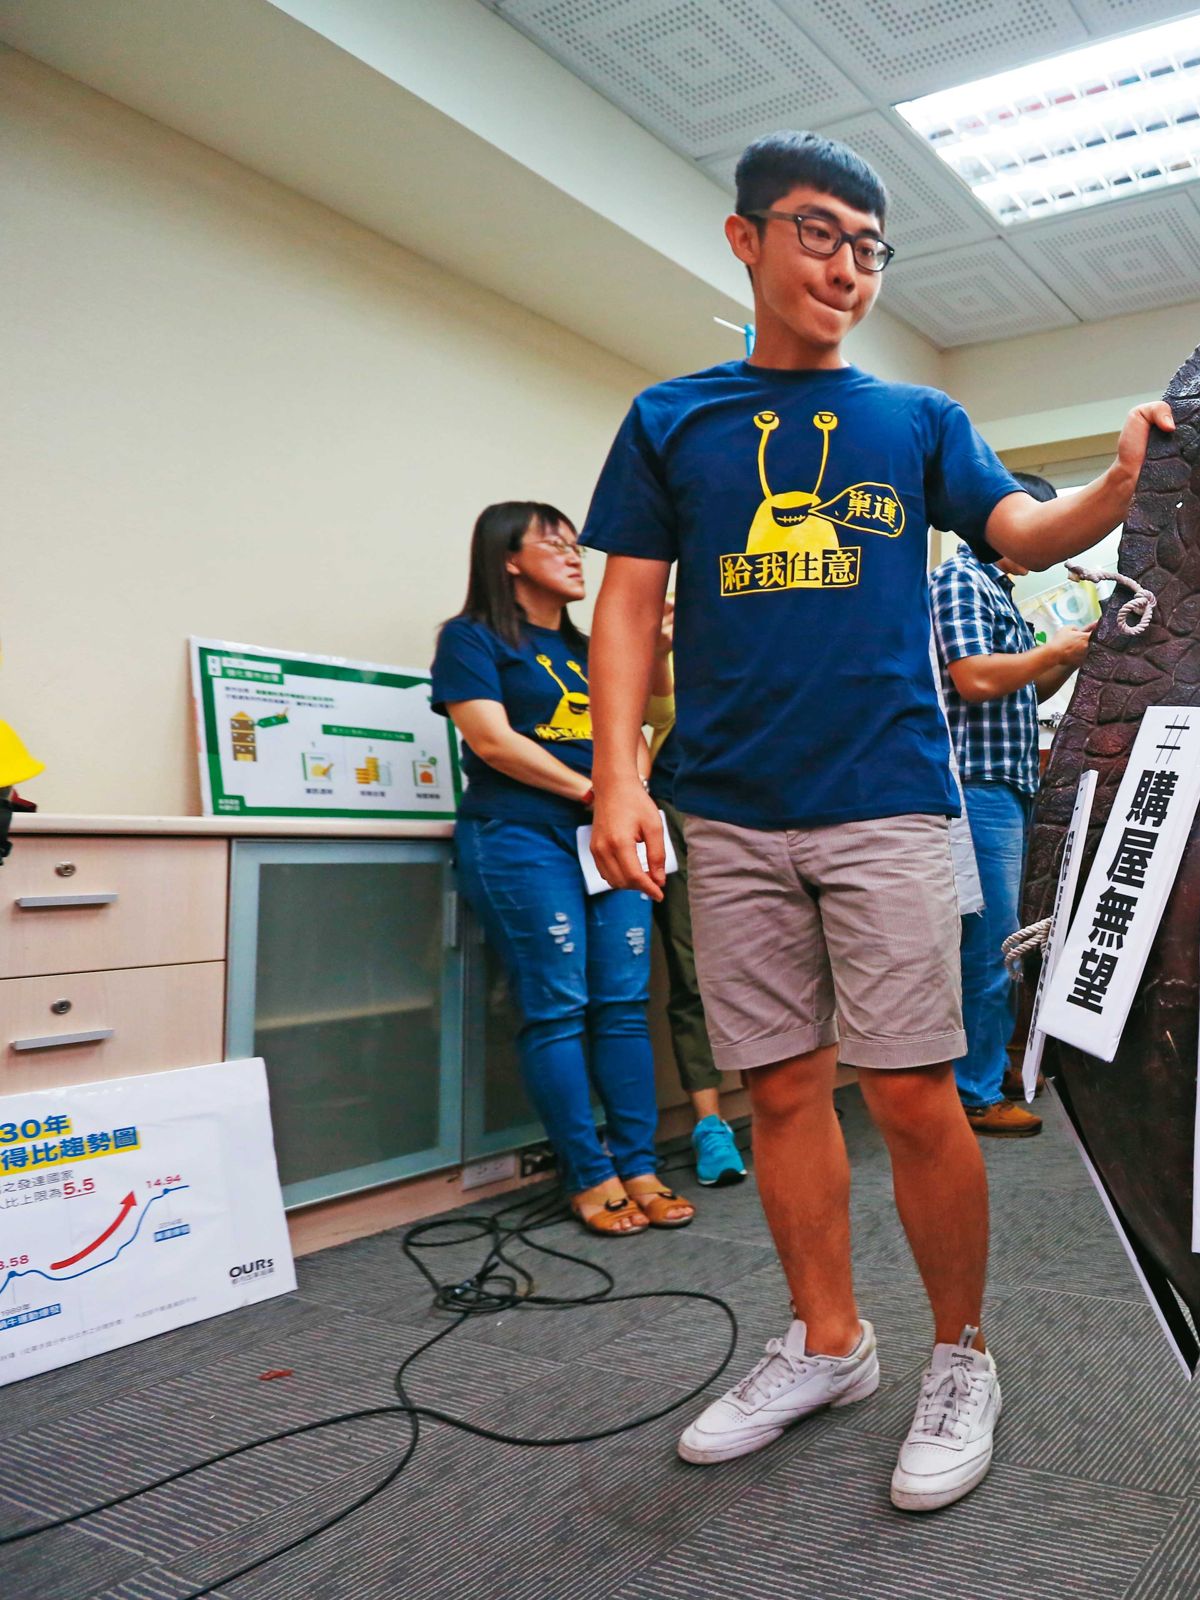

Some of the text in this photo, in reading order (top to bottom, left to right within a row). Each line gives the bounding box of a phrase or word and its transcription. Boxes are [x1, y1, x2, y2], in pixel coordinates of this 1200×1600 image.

[845, 490, 898, 529] 巢運
[723, 550, 857, 591] 給我住意
[0, 1114, 70, 1143] 30年
[146, 1174, 182, 1189] 14.94
[229, 1258, 274, 1278] OURs
